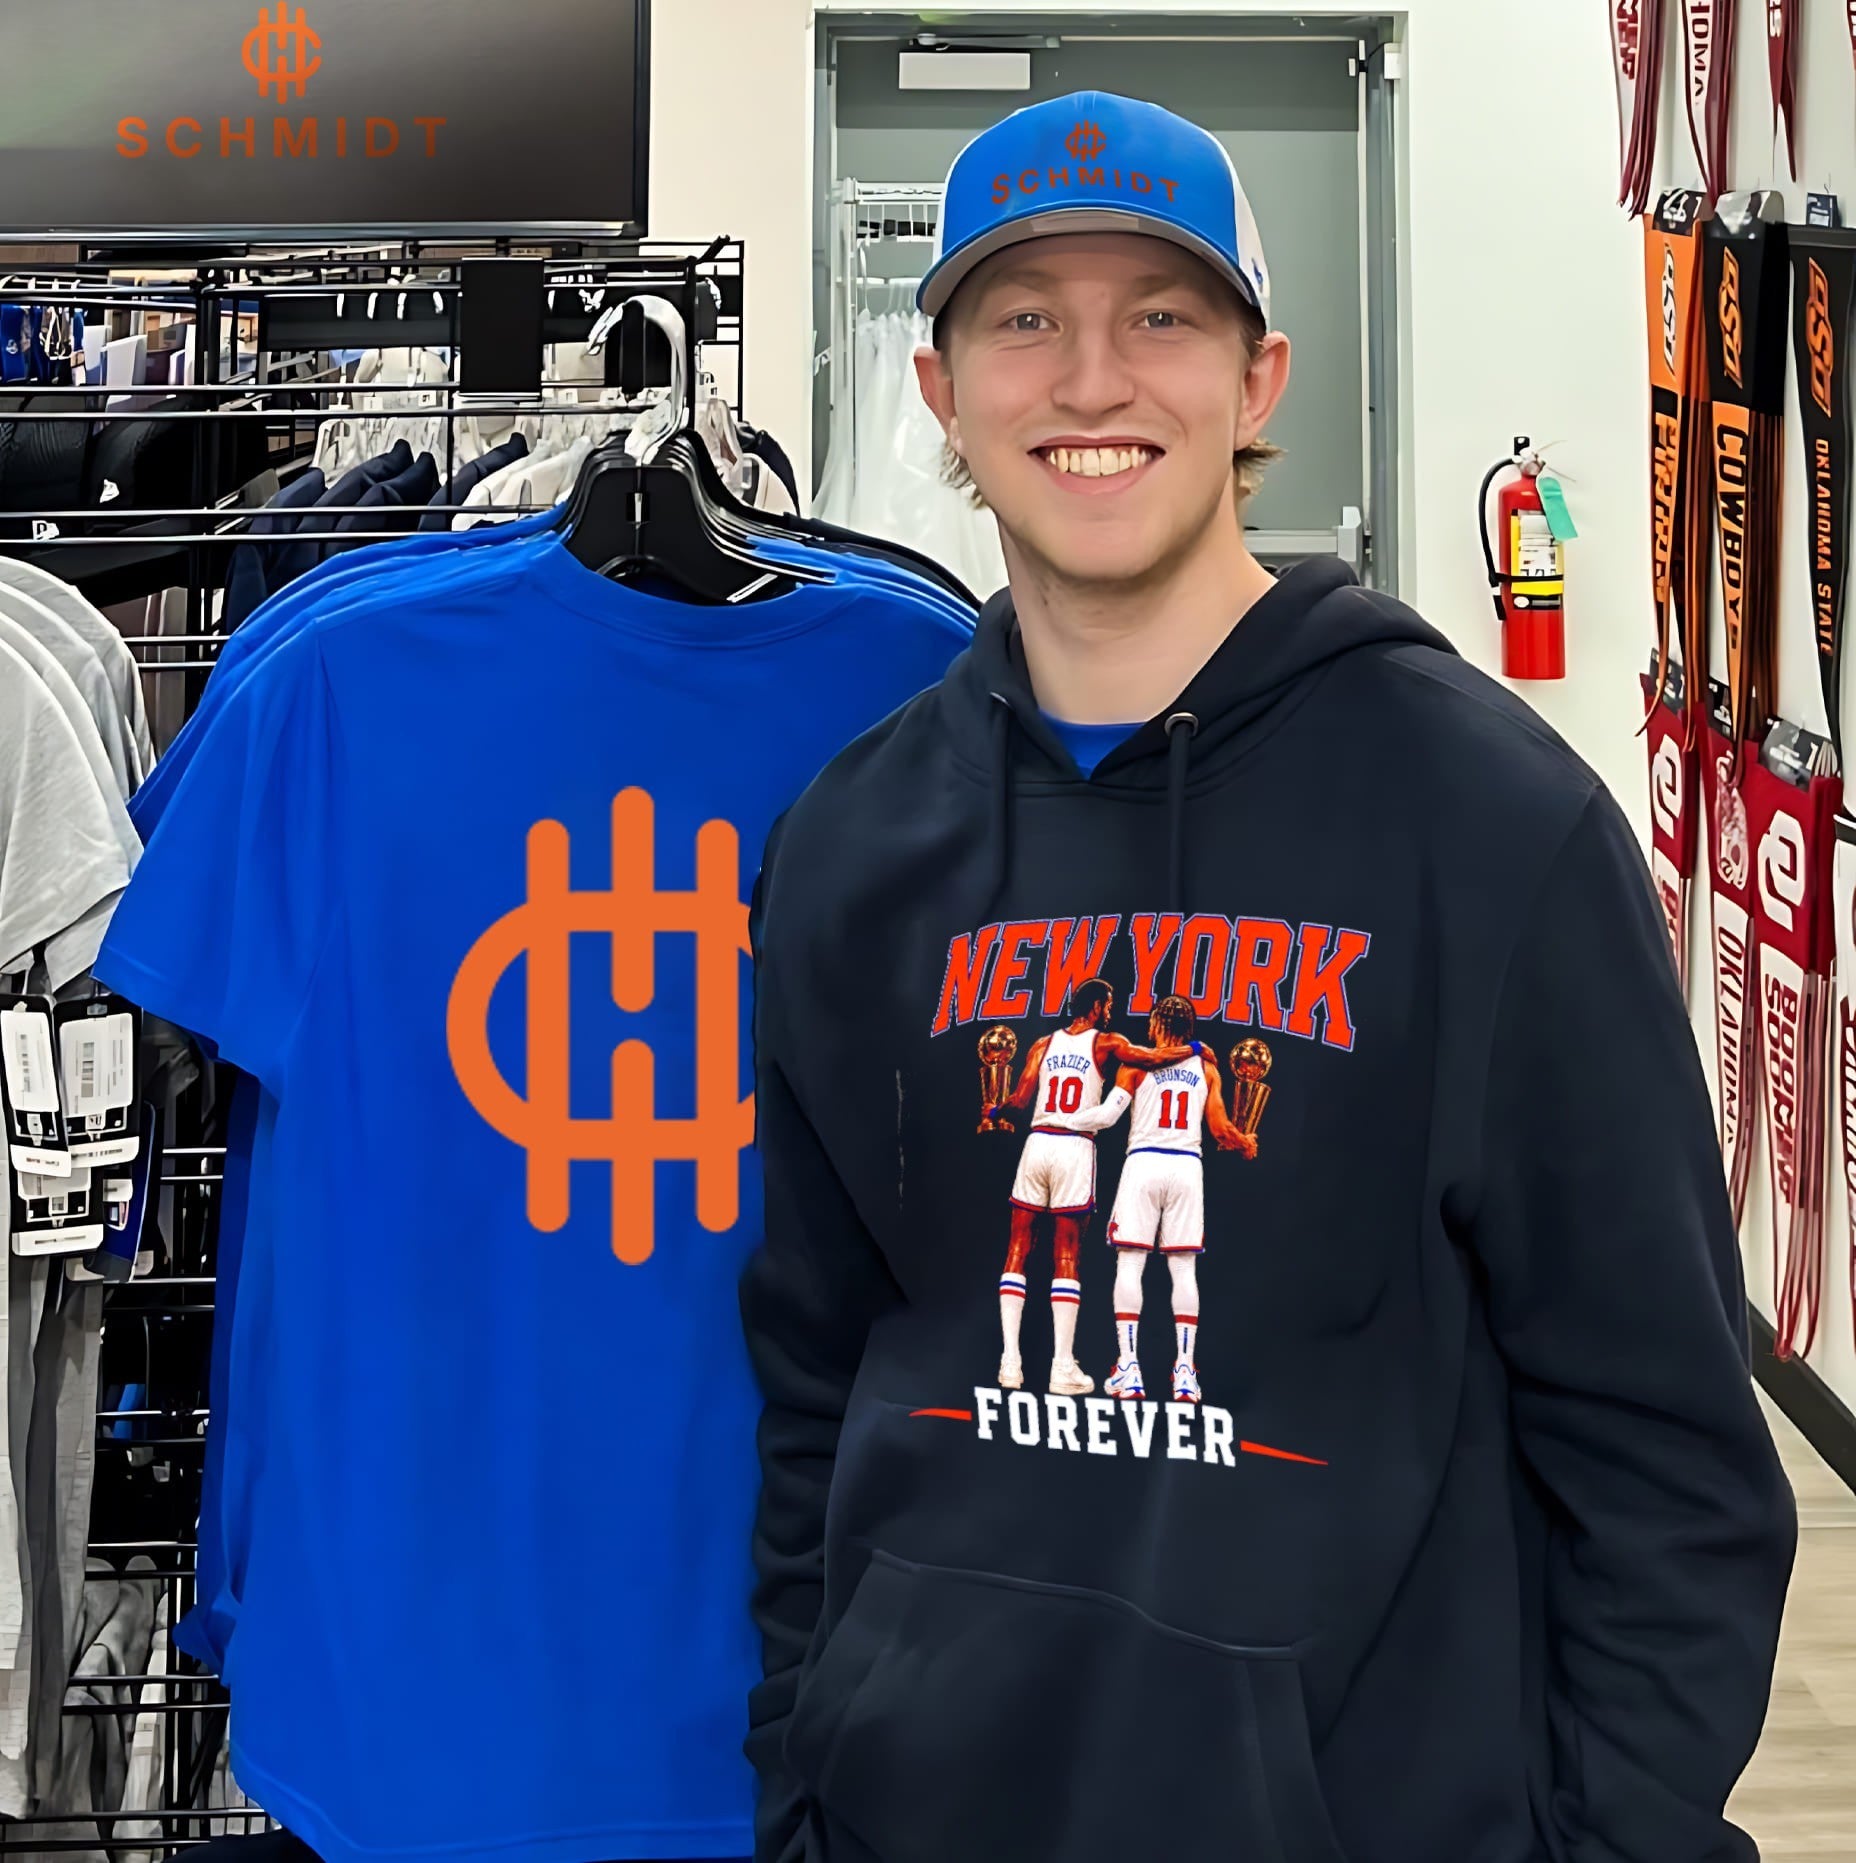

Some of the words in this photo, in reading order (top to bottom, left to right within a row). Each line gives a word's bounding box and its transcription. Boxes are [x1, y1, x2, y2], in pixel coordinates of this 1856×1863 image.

[116, 117, 447, 159] SCHMIDT
[991, 166, 1179, 205] SCHMIDT
[1815, 438, 1832, 571] OKLAHOMA
[930, 913, 1122, 1038] NEW
[1127, 912, 1371, 1052] YORK
[1046, 1054, 1091, 1074] FRAZIER
[1153, 1069, 1200, 1087] BRUNSON
[1045, 1076, 1083, 1114] 10
[1158, 1089, 1189, 1130] 11
[973, 1386, 1236, 1467] FOREVER
